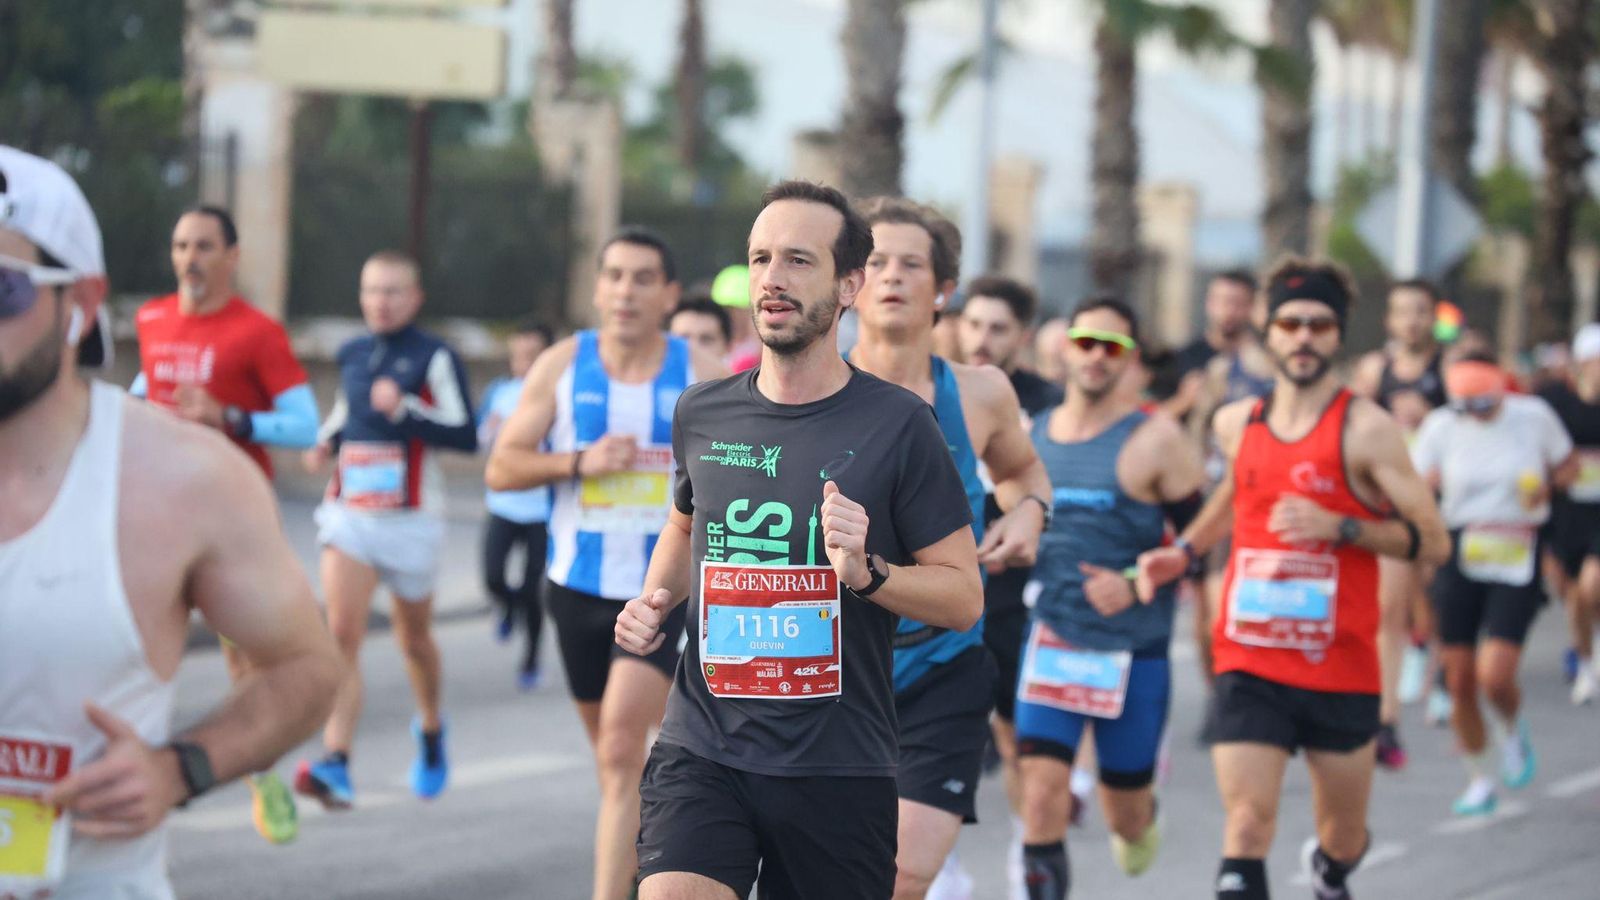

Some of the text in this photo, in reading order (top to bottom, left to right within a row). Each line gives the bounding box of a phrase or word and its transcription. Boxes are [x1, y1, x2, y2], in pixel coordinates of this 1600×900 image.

[711, 441, 753, 452] Schneider
[727, 449, 751, 457] Electric
[726, 457, 758, 468] PARIS
[735, 573, 827, 592] GENERALI
[736, 614, 800, 638] 1116
[750, 641, 785, 650] QUEVIN
[793, 666, 819, 676] 42K
